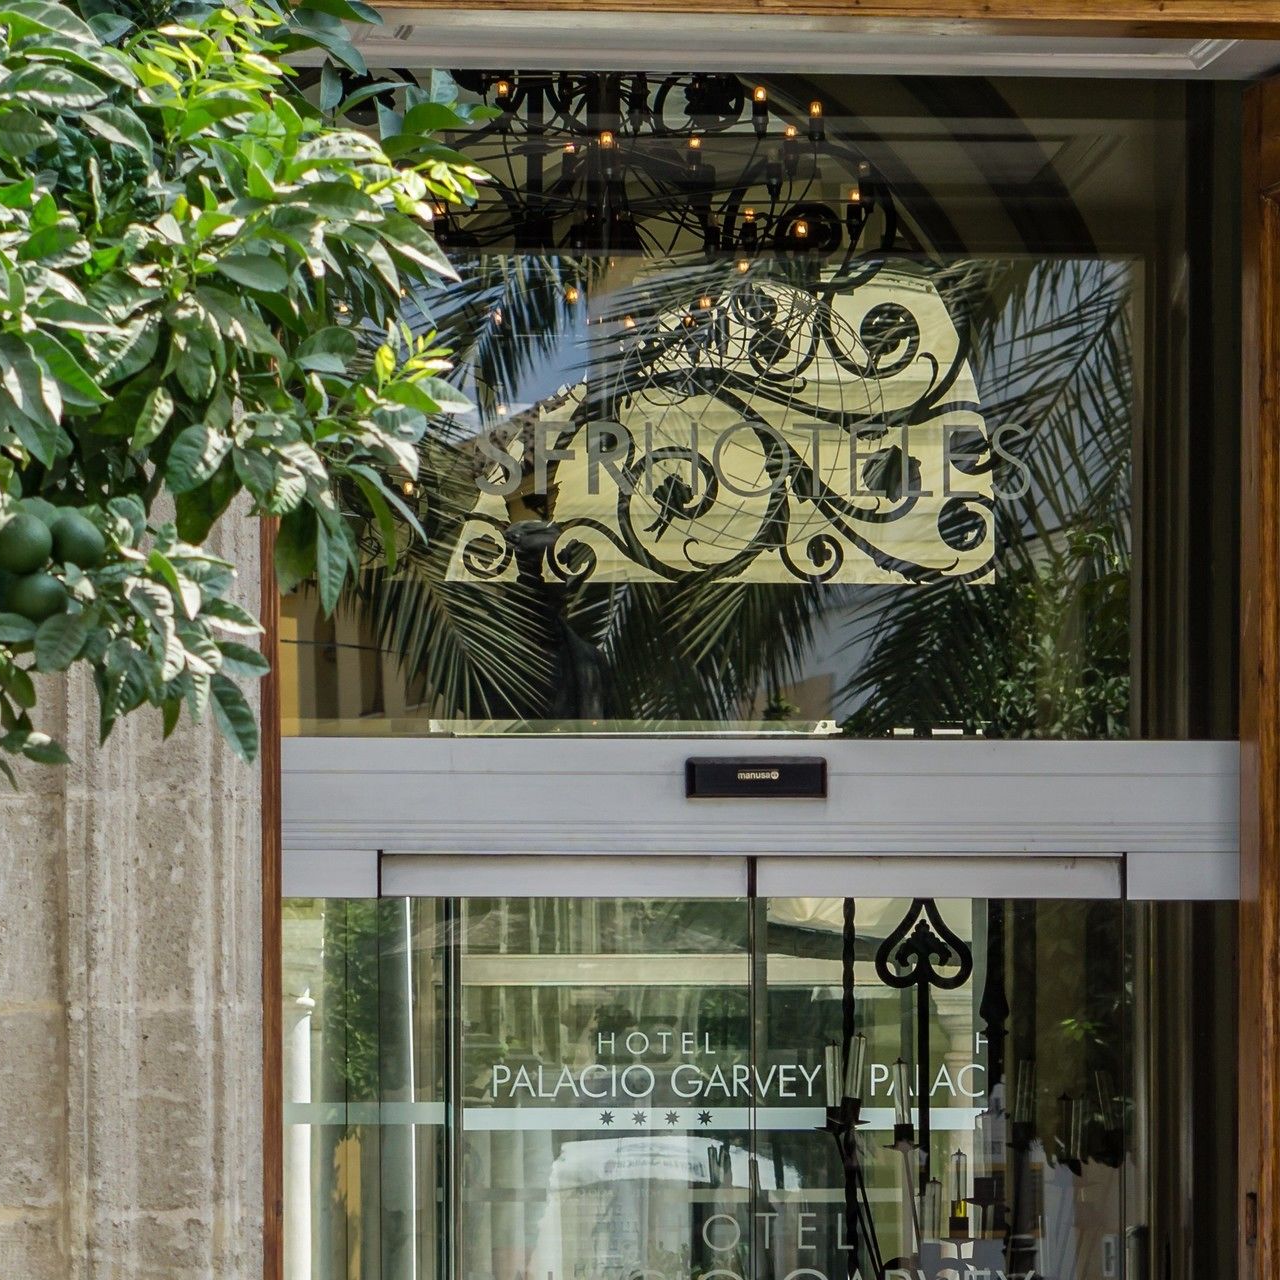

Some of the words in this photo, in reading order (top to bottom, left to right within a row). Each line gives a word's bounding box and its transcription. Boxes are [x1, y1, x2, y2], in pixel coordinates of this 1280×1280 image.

[737, 771, 771, 780] manusa
[598, 1032, 716, 1055] HOTEL
[492, 1064, 655, 1098] PALACIO
[671, 1064, 822, 1098] GARVEY
[702, 1213, 854, 1251] OTEL
